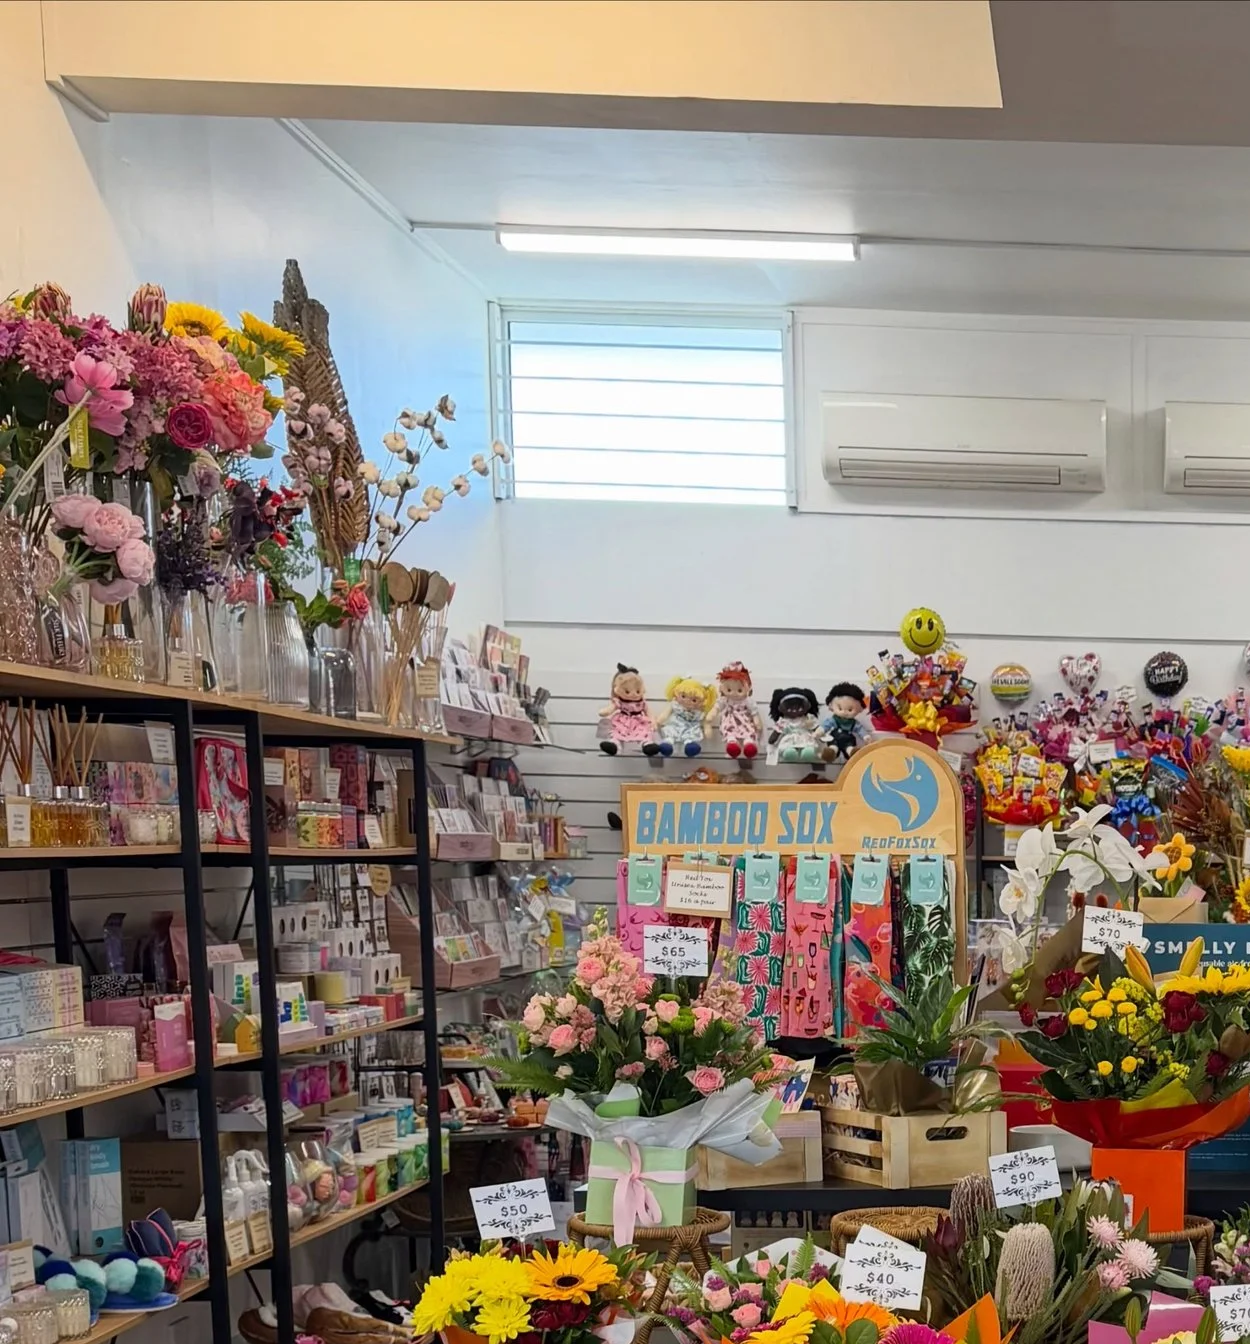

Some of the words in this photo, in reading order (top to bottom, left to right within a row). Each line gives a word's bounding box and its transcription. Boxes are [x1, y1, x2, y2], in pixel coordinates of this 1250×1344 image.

[636, 802, 769, 845] BAMBOO
[777, 802, 839, 844] SOX
[1098, 927, 1121, 939] $70
[661, 946, 686, 958] $65
[1010, 1170, 1036, 1184] $90
[500, 1202, 529, 1218] $50
[866, 1271, 895, 1287] $40
